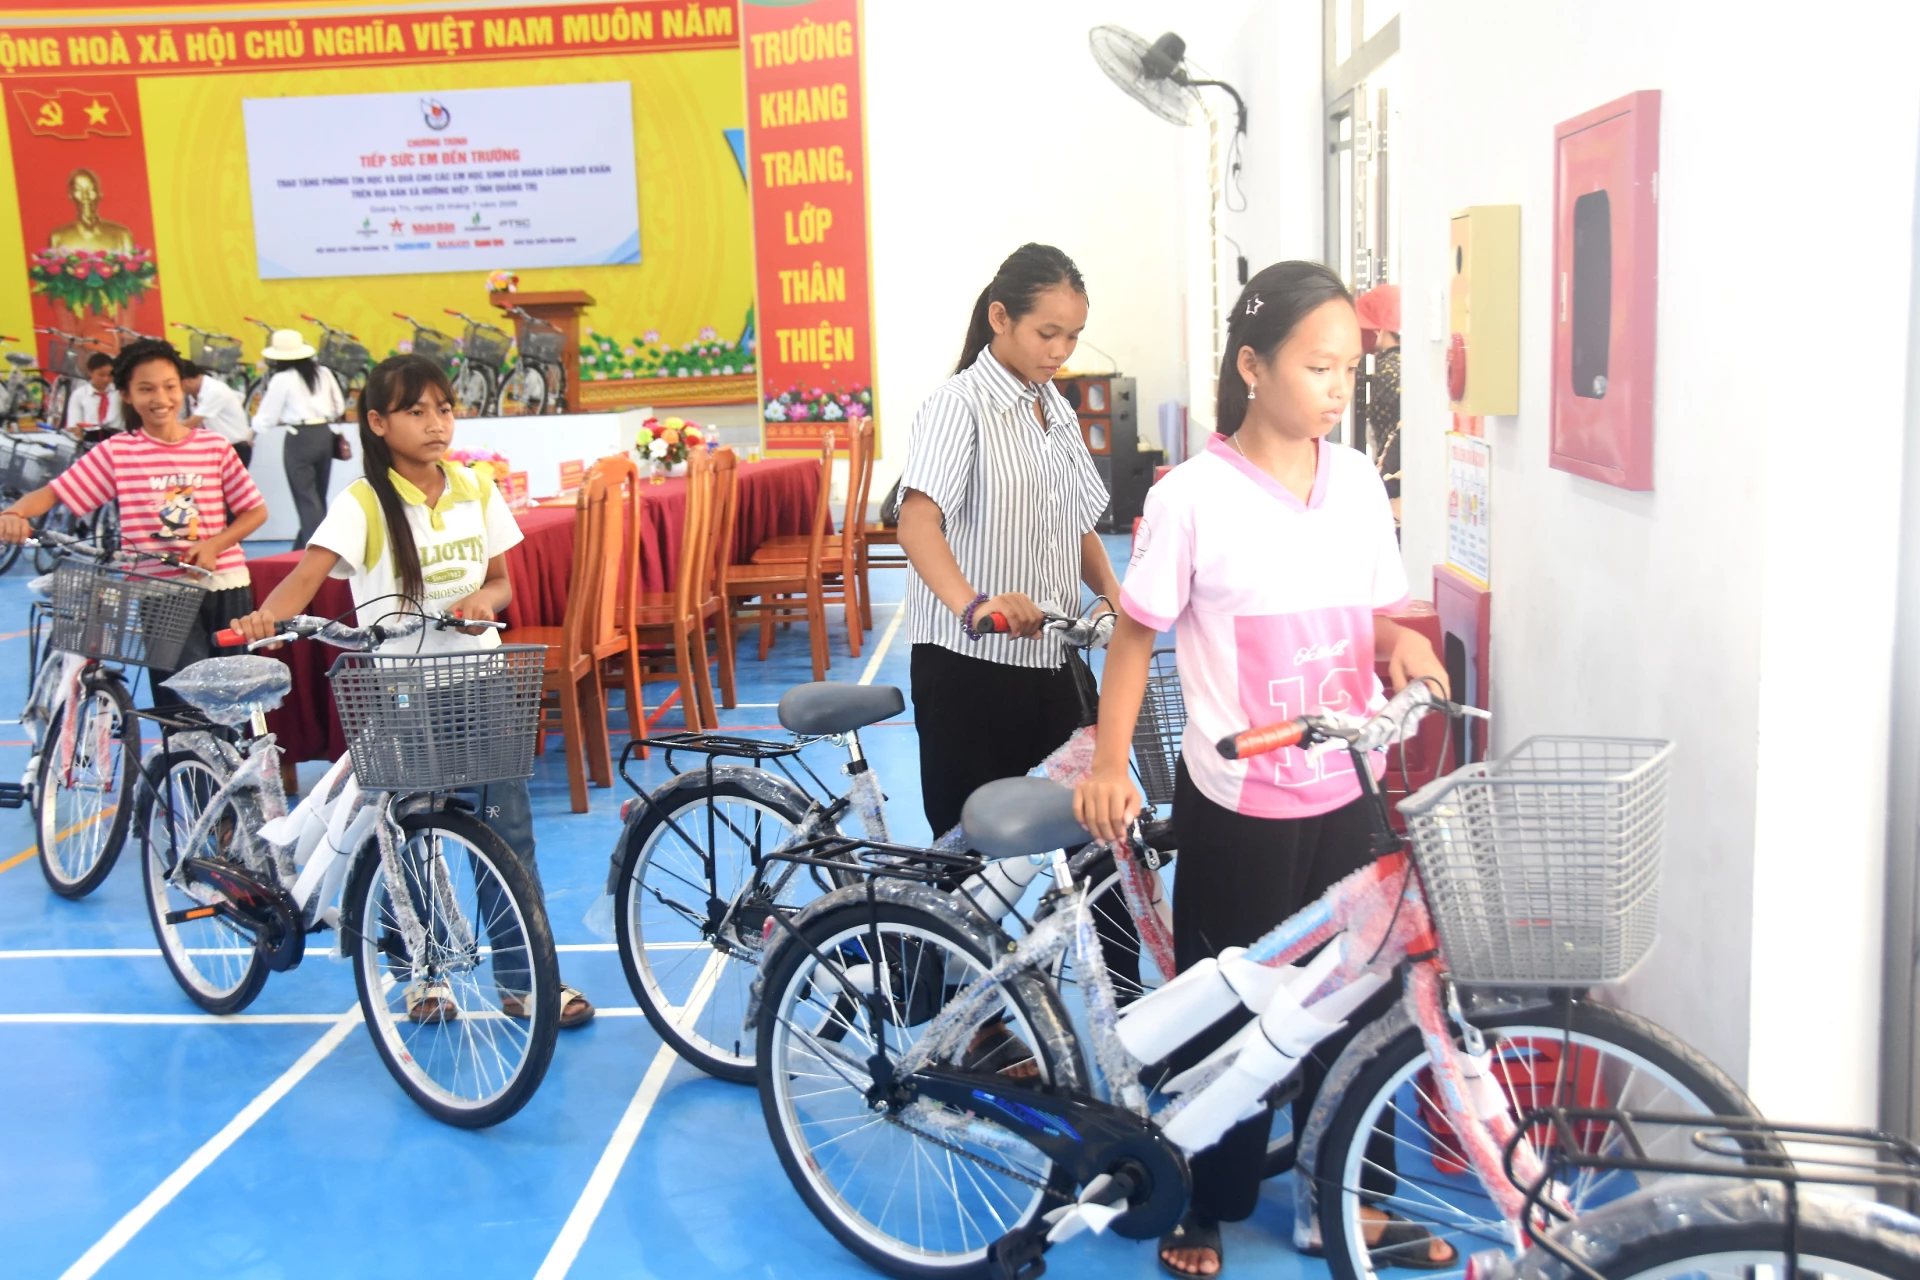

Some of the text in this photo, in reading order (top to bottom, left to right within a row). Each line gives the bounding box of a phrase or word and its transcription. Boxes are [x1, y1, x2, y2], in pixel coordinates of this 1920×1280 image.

[68, 29, 131, 66] HOÀ
[136, 29, 180, 63] XÃ
[186, 27, 237, 67] HỘI
[245, 20, 304, 59] CHỦ
[313, 19, 405, 56] NGHĨA
[411, 15, 475, 56] VIỆT
[483, 17, 554, 48] NAM
[562, 7, 653, 44] MUÔN
[661, 3, 733, 38] NĂM
[750, 17, 853, 69] TRƯỜNG
[760, 83, 848, 128] KHANG
[360, 147, 521, 167] TIẾP SỨC EM ĐẾN TRƯỜNG
[761, 145, 852, 187] TRANG,
[784, 202, 833, 245] LỚP
[779, 261, 846, 304] THÂN
[775, 320, 855, 369] THIỆN
